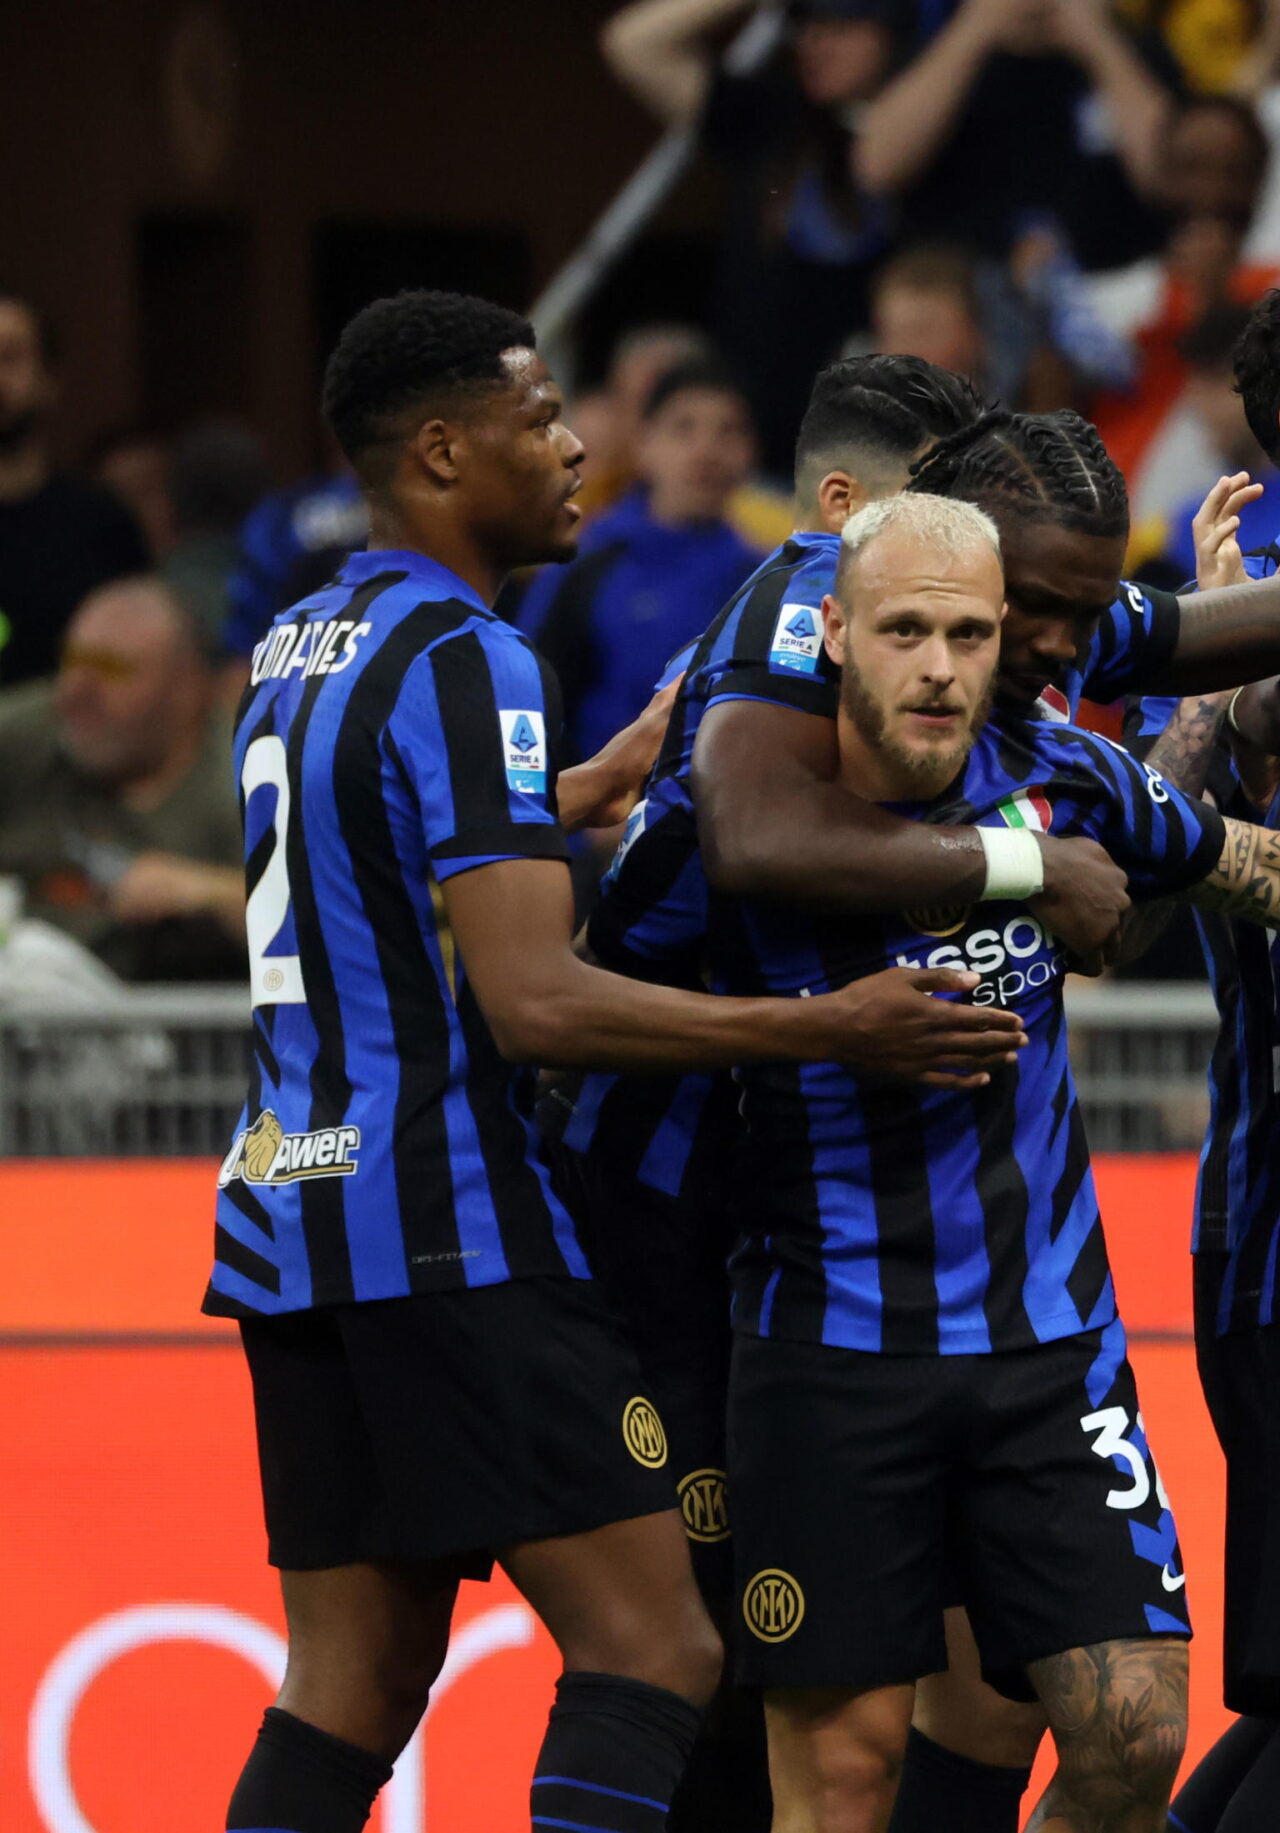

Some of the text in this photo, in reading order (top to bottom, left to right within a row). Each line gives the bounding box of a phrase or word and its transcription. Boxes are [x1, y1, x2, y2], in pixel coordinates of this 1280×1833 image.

[251, 620, 372, 687] UMFIES
[510, 755, 532, 763] SERIE
[242, 735, 307, 1005] 2
[972, 954, 1062, 1006] spor
[262, 1129, 357, 1182] pwer
